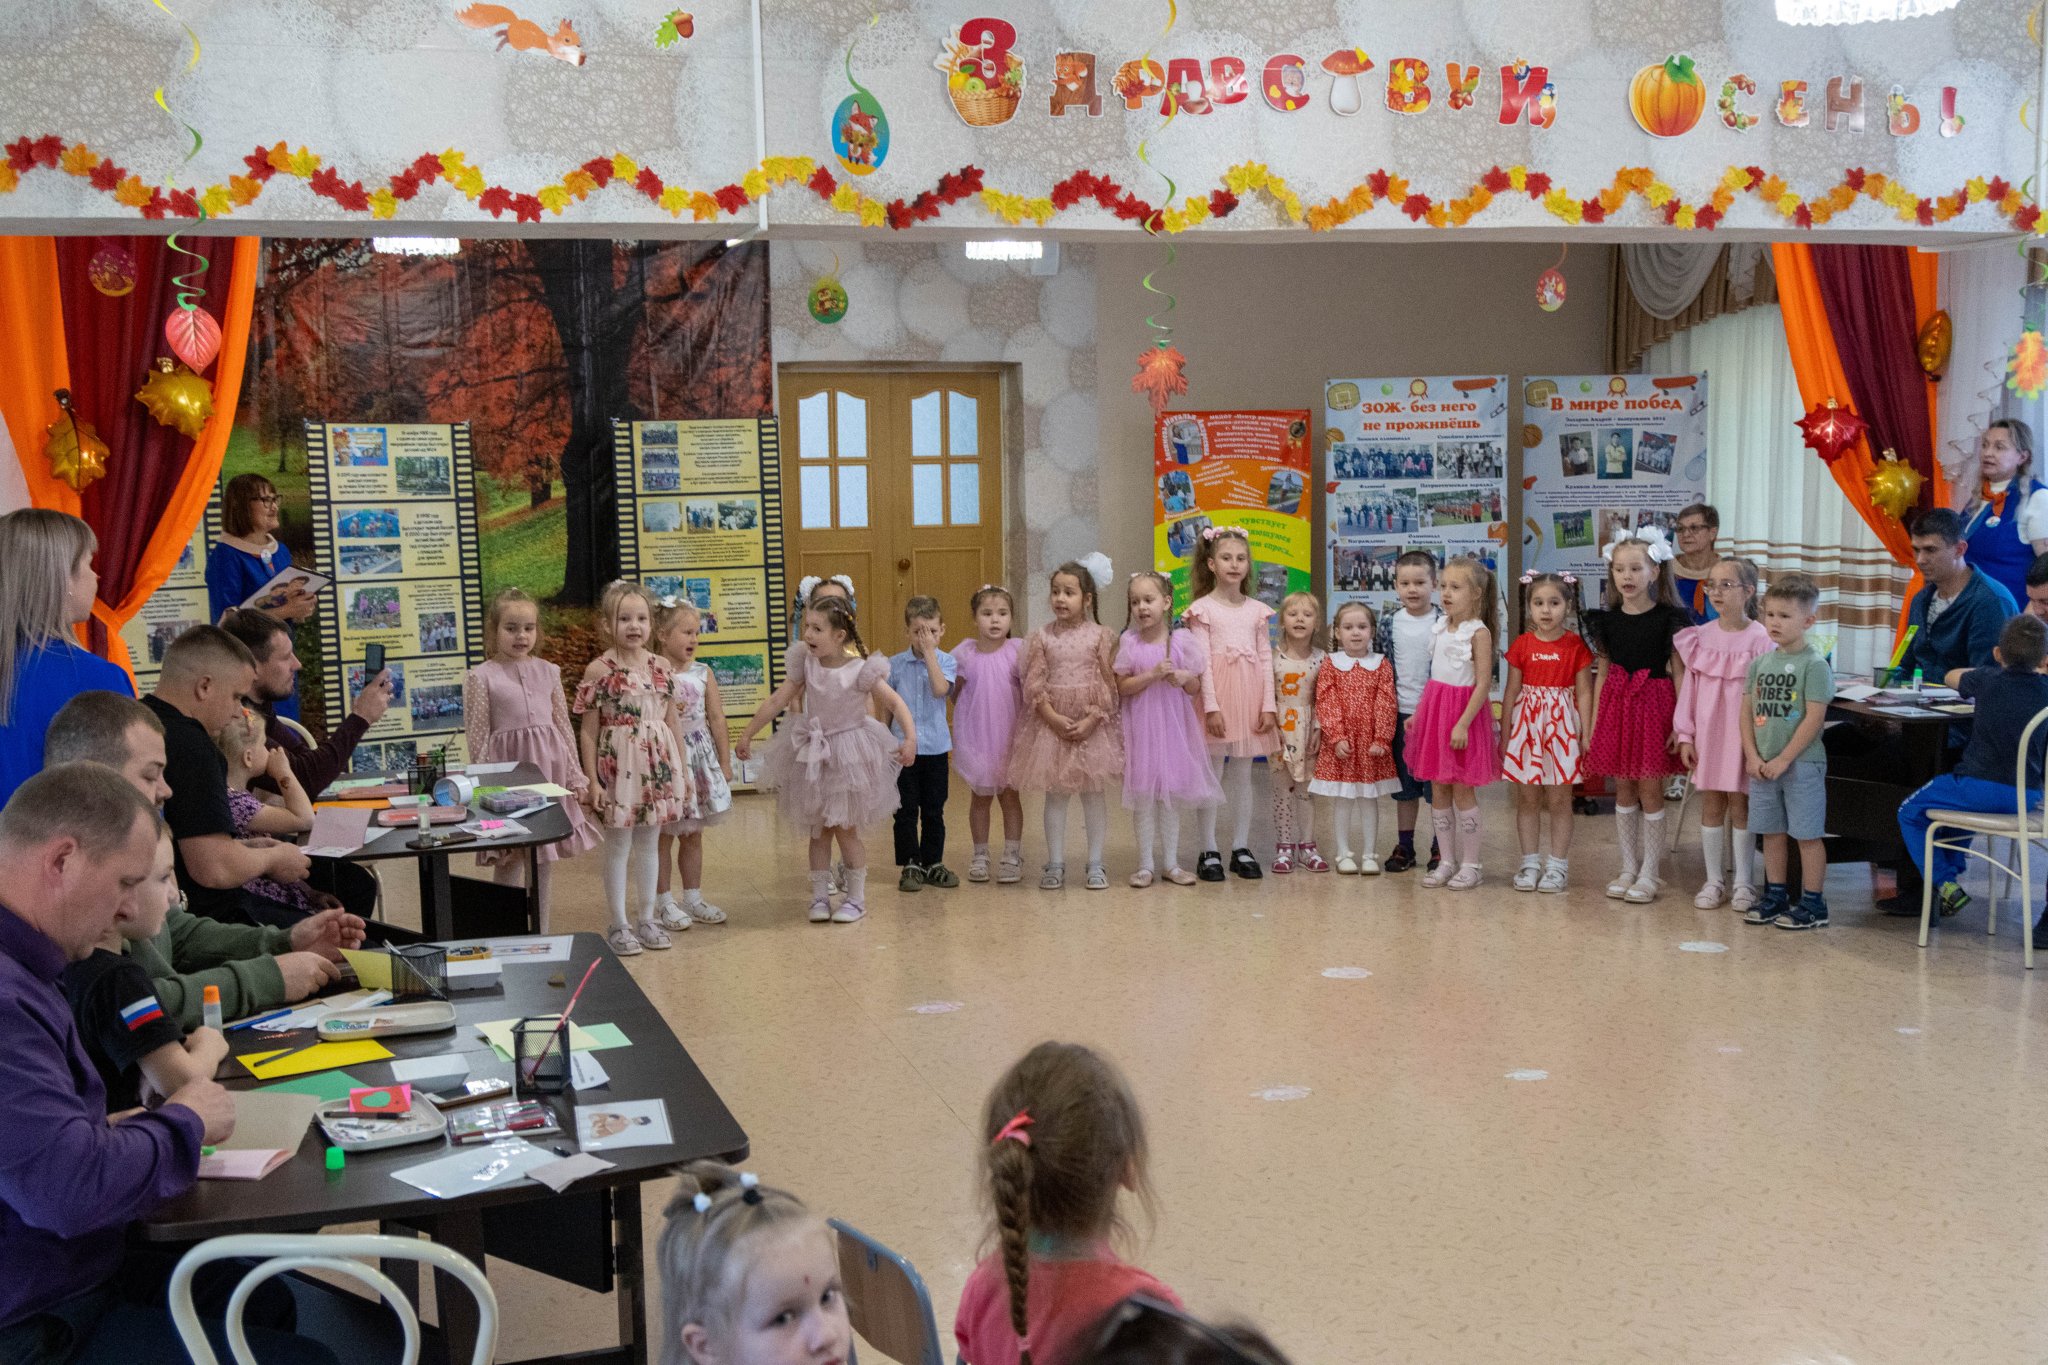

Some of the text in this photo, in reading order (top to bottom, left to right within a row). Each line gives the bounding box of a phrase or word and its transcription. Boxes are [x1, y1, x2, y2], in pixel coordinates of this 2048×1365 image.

[1410, 400, 1437, 413] без
[1441, 402, 1477, 412] него
[1550, 393, 1683, 413] В мире побед
[1363, 417, 1481, 432] не проживёшь
[1757, 673, 1797, 688] GOOD
[1756, 687, 1792, 702] VIBES
[1756, 702, 1793, 718] ONLY
